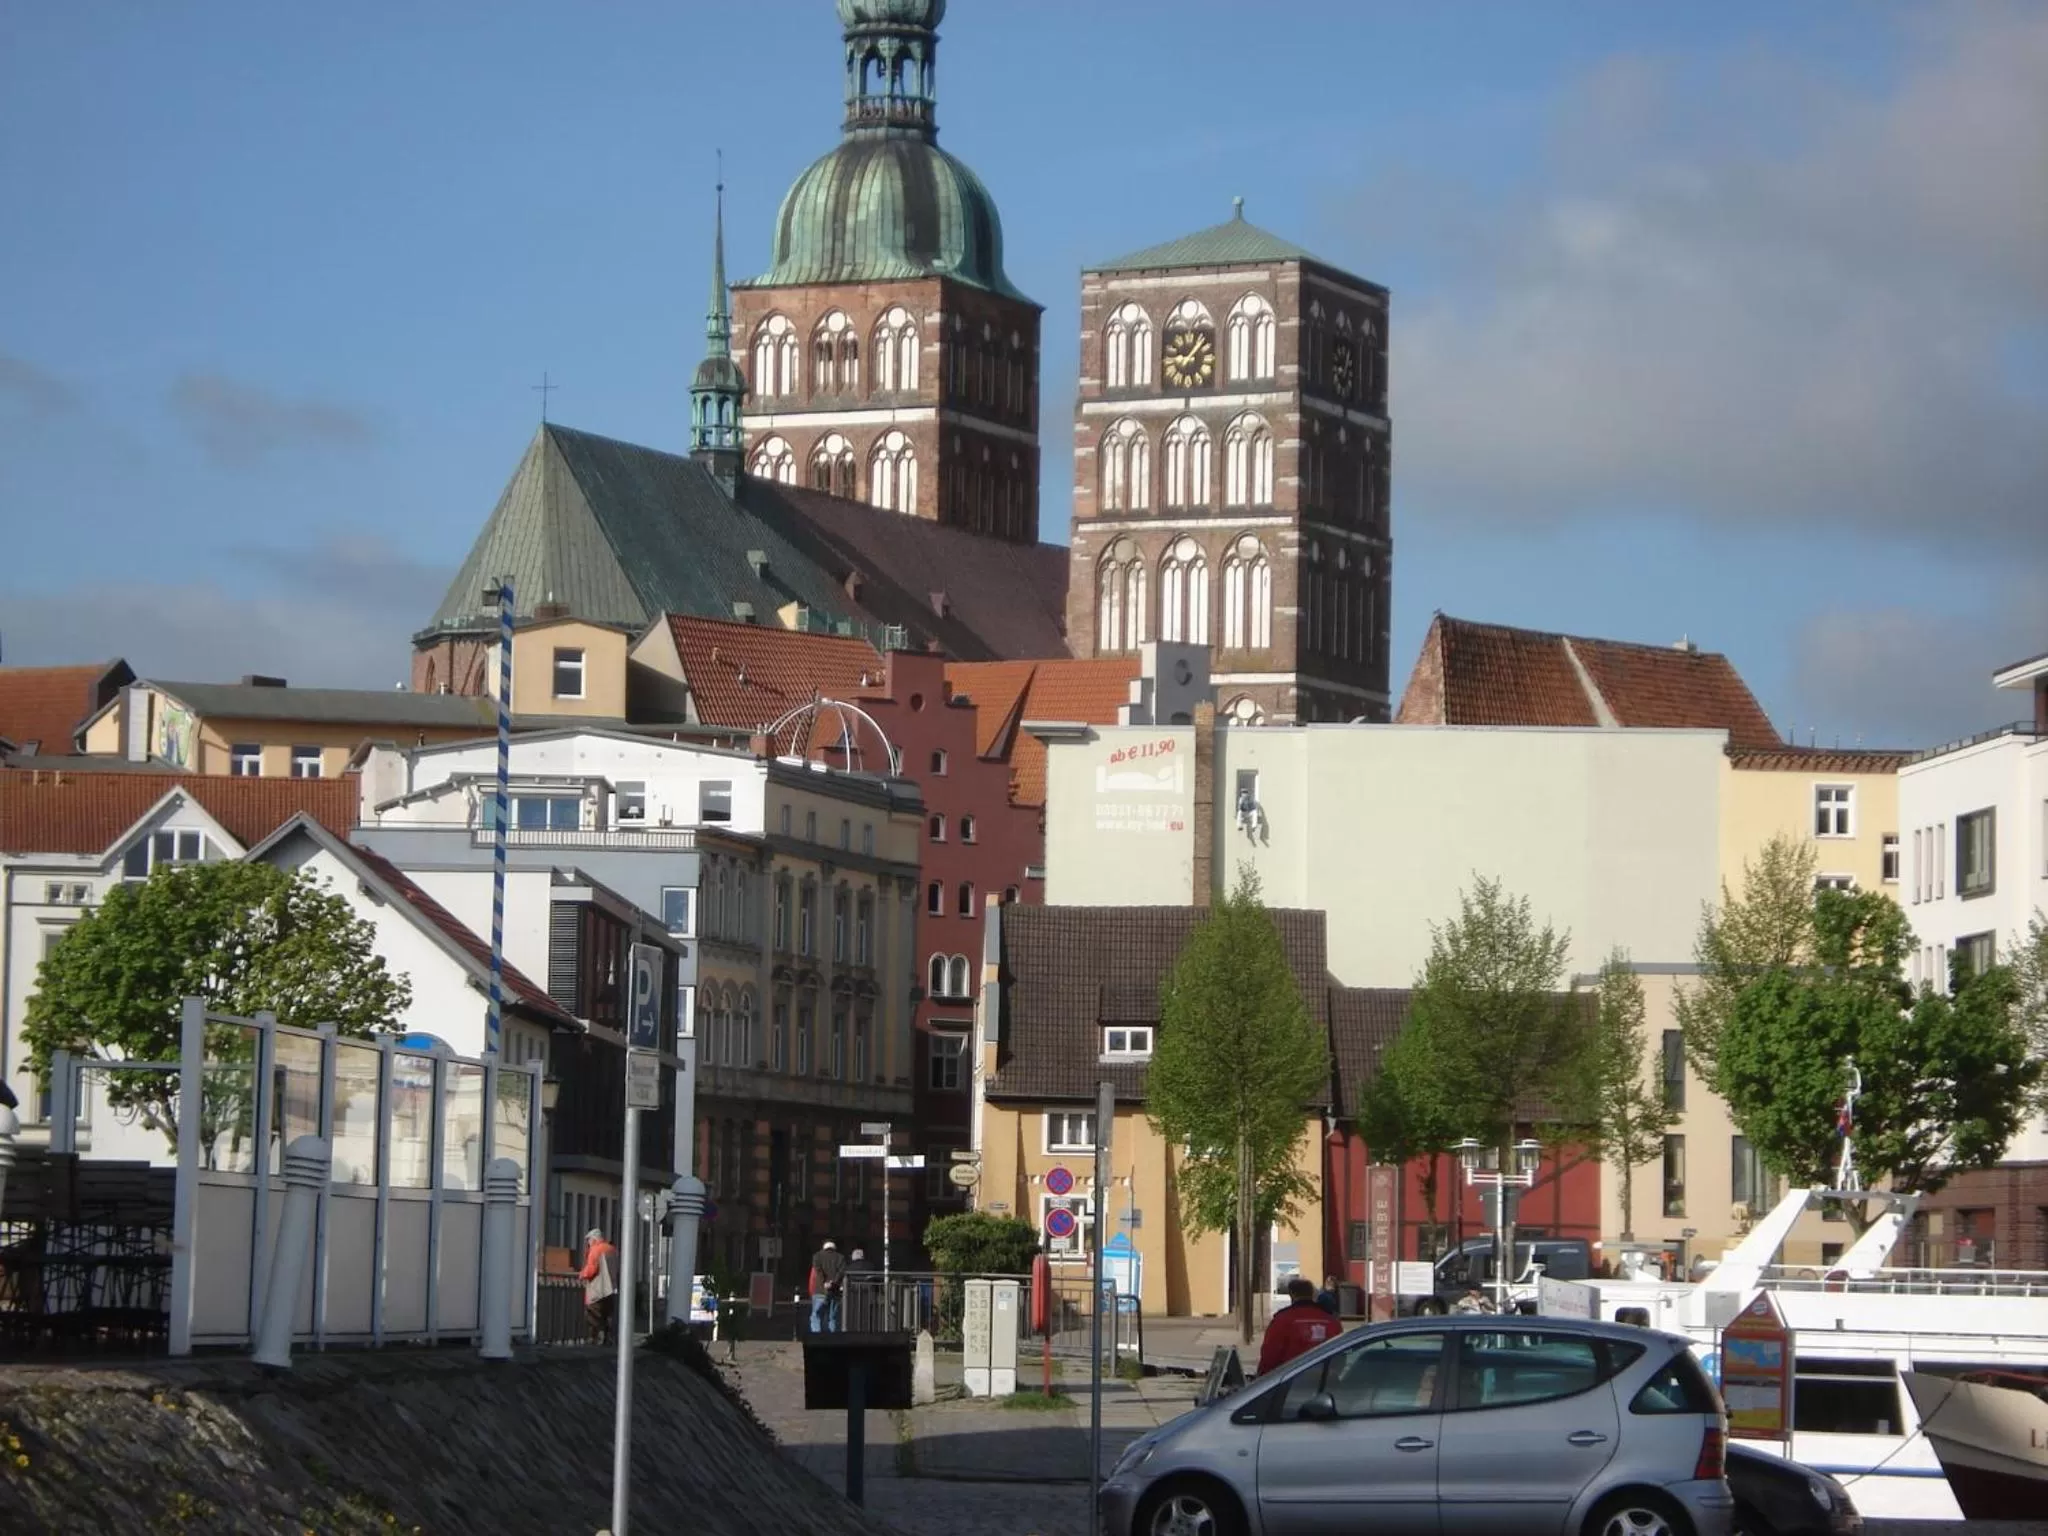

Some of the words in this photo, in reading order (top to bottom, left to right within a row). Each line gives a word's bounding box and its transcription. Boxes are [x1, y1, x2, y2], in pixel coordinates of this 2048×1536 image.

[1110, 748, 1125, 764] ab
[1141, 738, 1175, 757] 11,90
[634, 959, 653, 1033] P
[1376, 1199, 1388, 1299] WELTERBE
[2028, 1428, 2048, 1450] L
